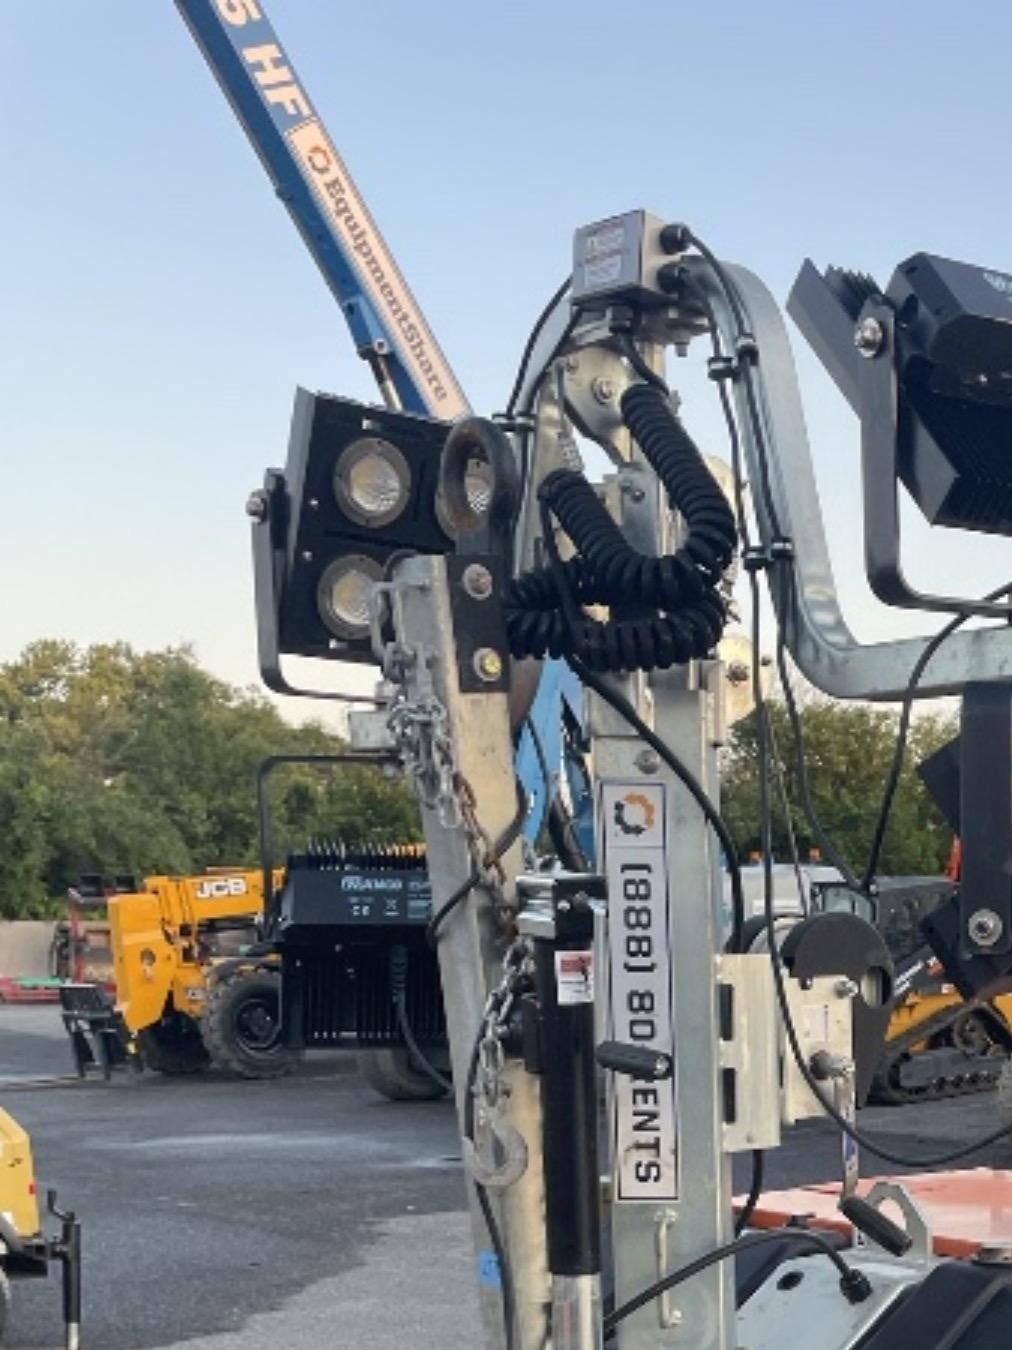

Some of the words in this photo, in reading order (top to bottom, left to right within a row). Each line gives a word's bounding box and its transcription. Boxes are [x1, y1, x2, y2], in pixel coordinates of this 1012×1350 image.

[241, 43, 313, 118] HF
[323, 177, 448, 400] EquipmentShare
[196, 878, 247, 898] JCB
[627, 989, 661, 1183] 80ENTS
